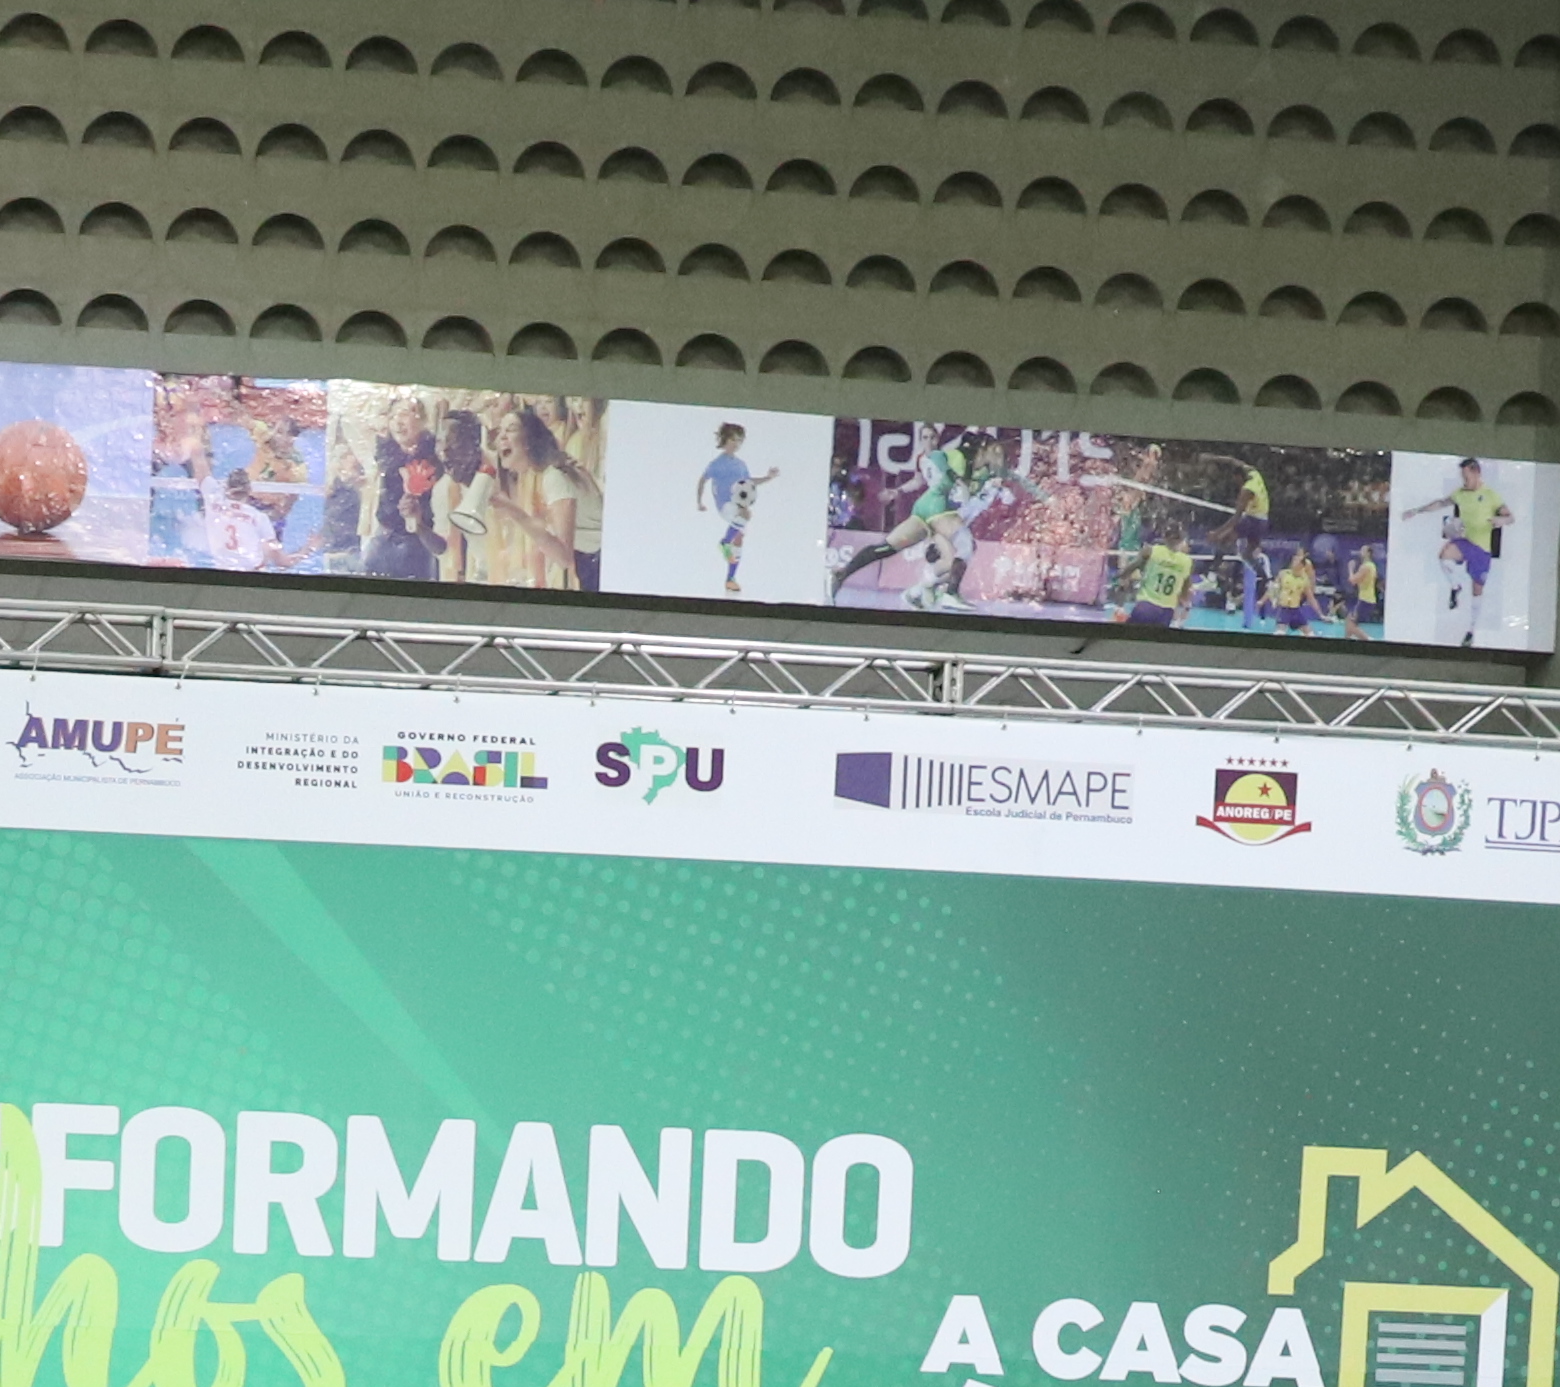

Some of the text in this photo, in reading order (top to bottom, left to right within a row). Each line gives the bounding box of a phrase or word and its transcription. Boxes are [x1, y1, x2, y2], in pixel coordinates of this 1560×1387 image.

[265, 731, 360, 745] MINISTÉRIO DA
[396, 731, 537, 746] GOVERNO FEDERAL
[245, 745, 360, 760] INTEGRAÇÃO E DO
[237, 760, 359, 774] DESENVOLVIMENTO
[381, 745, 549, 790] BRASIL
[594, 741, 726, 793] SPU
[294, 777, 359, 789] REGIONAL
[966, 764, 1133, 811] ESMAPE
[394, 789, 431, 800] UNIÃO
[444, 792, 535, 804] RECONSTRUÇÃO
[964, 806, 1134, 825] Escola Judicial de Pernambuco
[1215, 805, 1293, 821] ANOREG/PE
[919, 1294, 1005, 1377] A
